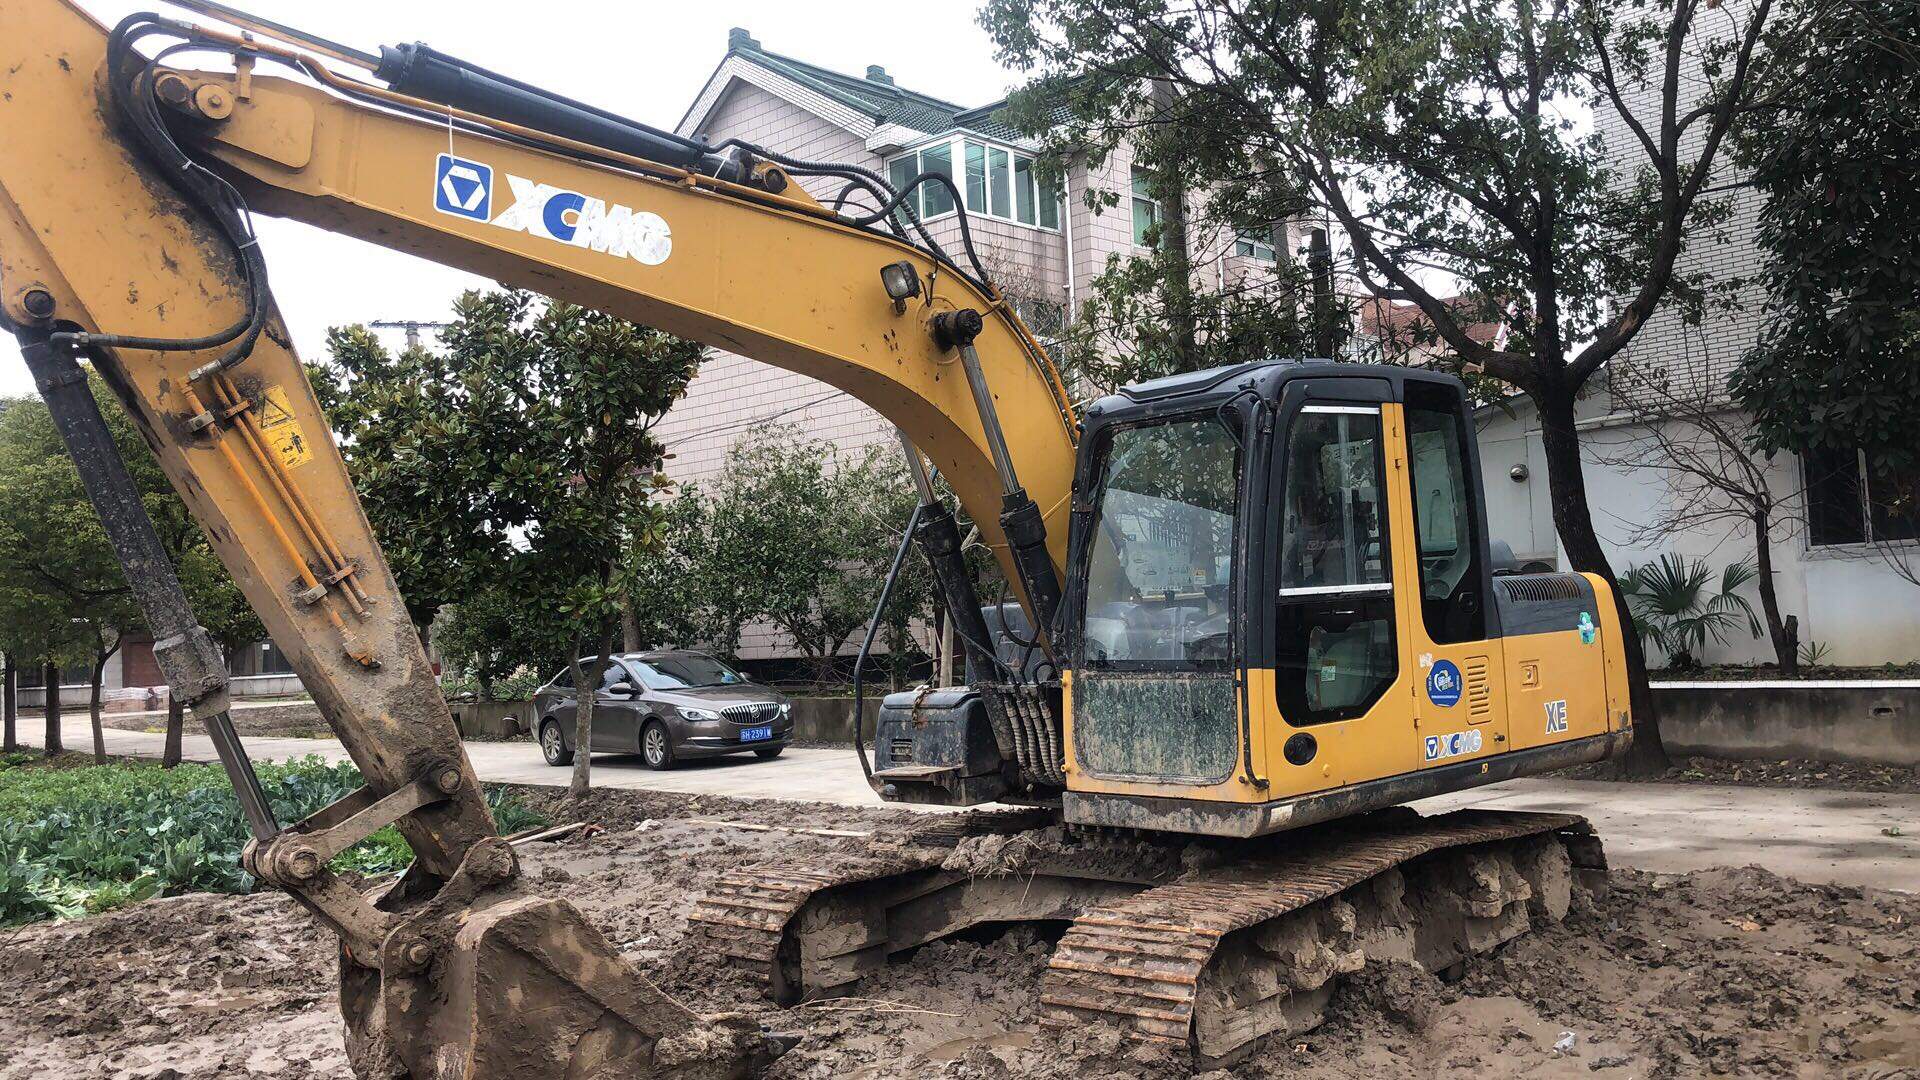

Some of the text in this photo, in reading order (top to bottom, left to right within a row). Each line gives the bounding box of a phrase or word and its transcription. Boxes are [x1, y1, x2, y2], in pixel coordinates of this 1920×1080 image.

[489, 173, 672, 266] XCMG
[1544, 699, 1567, 734] XE
[1438, 729, 1482, 757] XCMG
